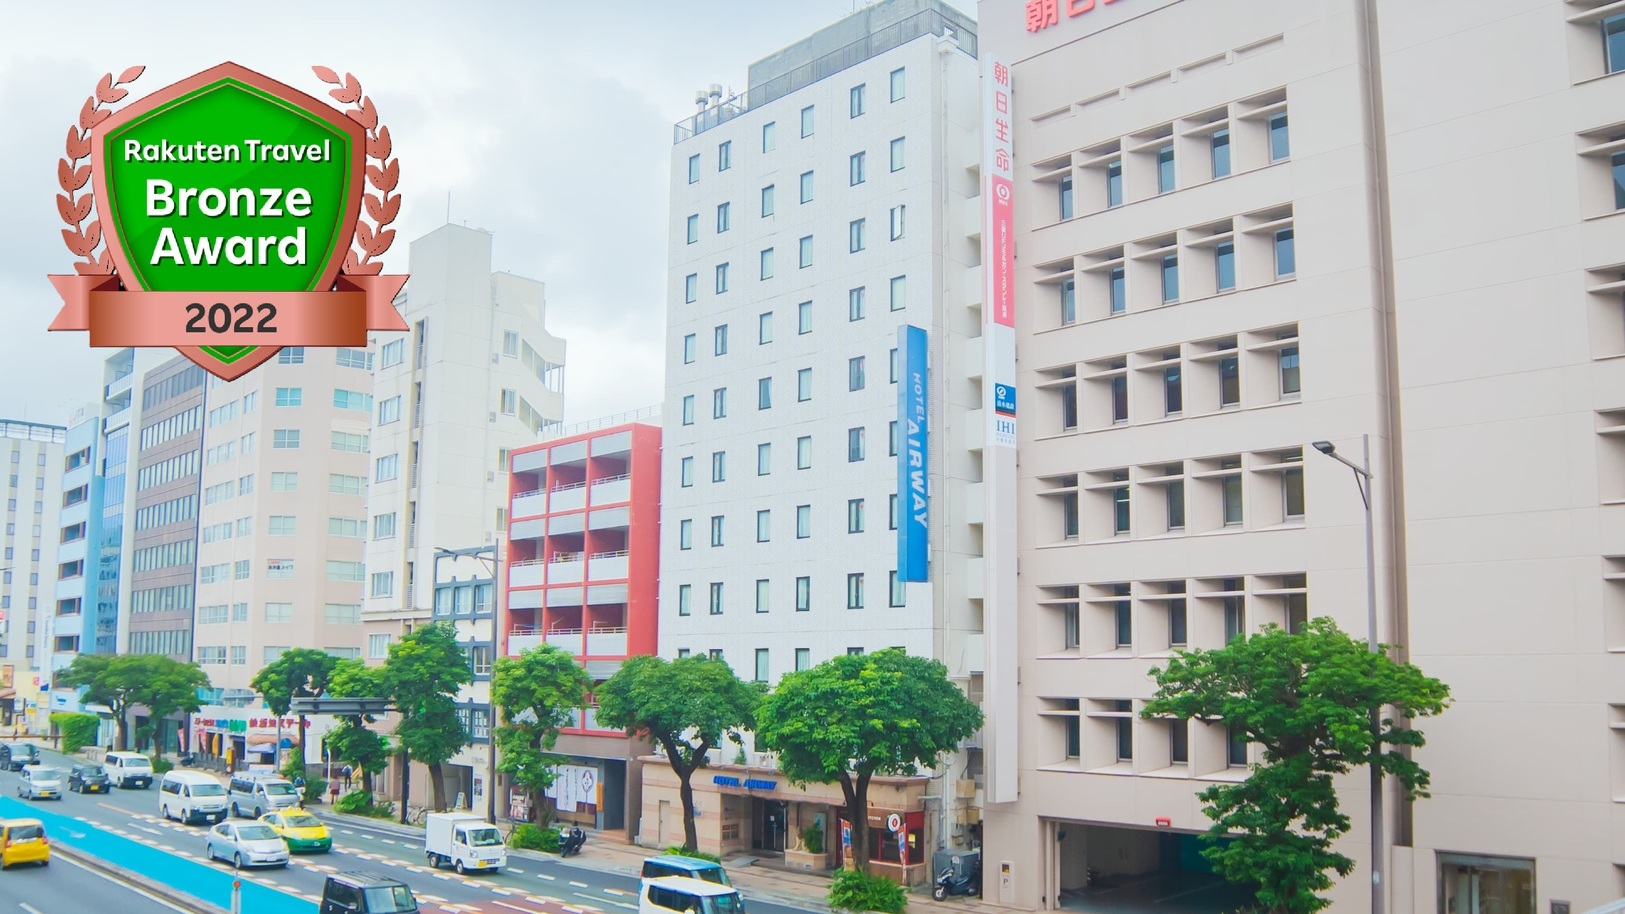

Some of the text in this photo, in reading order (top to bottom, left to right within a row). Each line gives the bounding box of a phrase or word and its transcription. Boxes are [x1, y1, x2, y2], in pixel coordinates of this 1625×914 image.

[1025, 0, 1121, 32] 朝日
[994, 61, 1009, 172] 朝日生命
[913, 372, 925, 423] HOTEL
[996, 420, 1015, 435] IHI
[907, 418, 928, 529] AIRWAY
